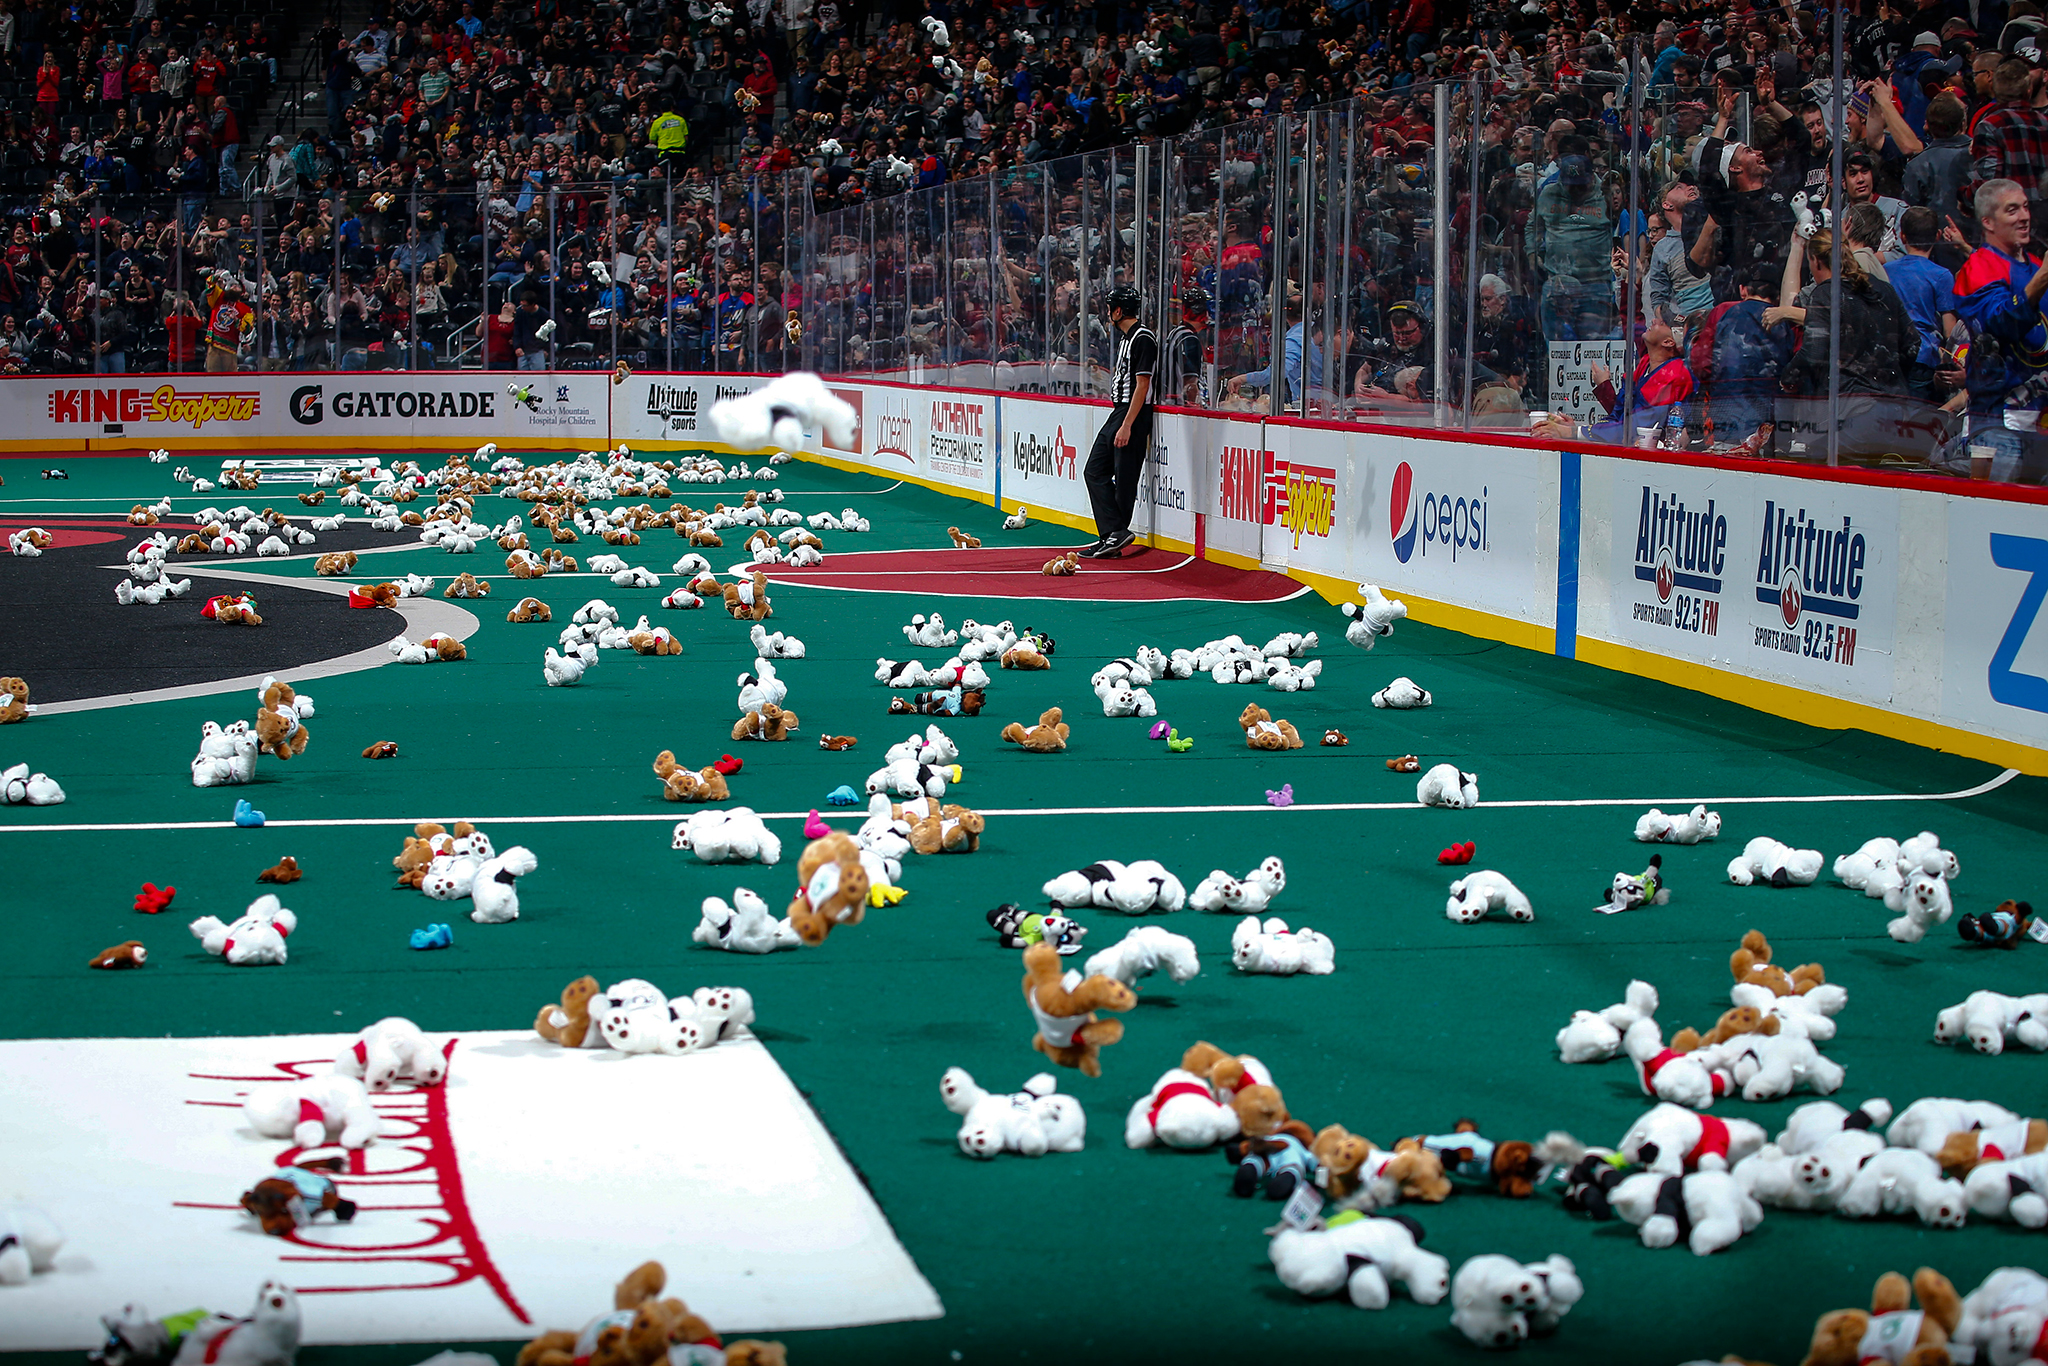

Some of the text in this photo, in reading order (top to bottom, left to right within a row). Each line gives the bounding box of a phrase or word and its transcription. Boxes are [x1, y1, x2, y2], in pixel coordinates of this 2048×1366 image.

[55, 384, 256, 429] KING Soopers
[332, 391, 495, 417] GATORADE
[537, 406, 590, 416] Rocky Mountain
[647, 383, 698, 410] Altitude
[529, 416, 596, 425] Hospital for Children
[671, 417, 696, 431] sports
[877, 396, 912, 457] uchealth
[931, 401, 983, 437] AUTHENTIC
[931, 434, 983, 462] PERFORMANCE
[1013, 432, 1054, 480] KeyBank
[1152, 474, 1185, 510] Children
[1222, 446, 1275, 525] KING
[1422, 485, 1488, 563] pepsi
[1635, 485, 1727, 576] Altitude
[1756, 500, 1866, 600] Altitude
[1632, 594, 1719, 636] SPORTS RADIO 92.5 FM
[1754, 619, 1857, 666] SPORTS RADIO 92.5 FM
